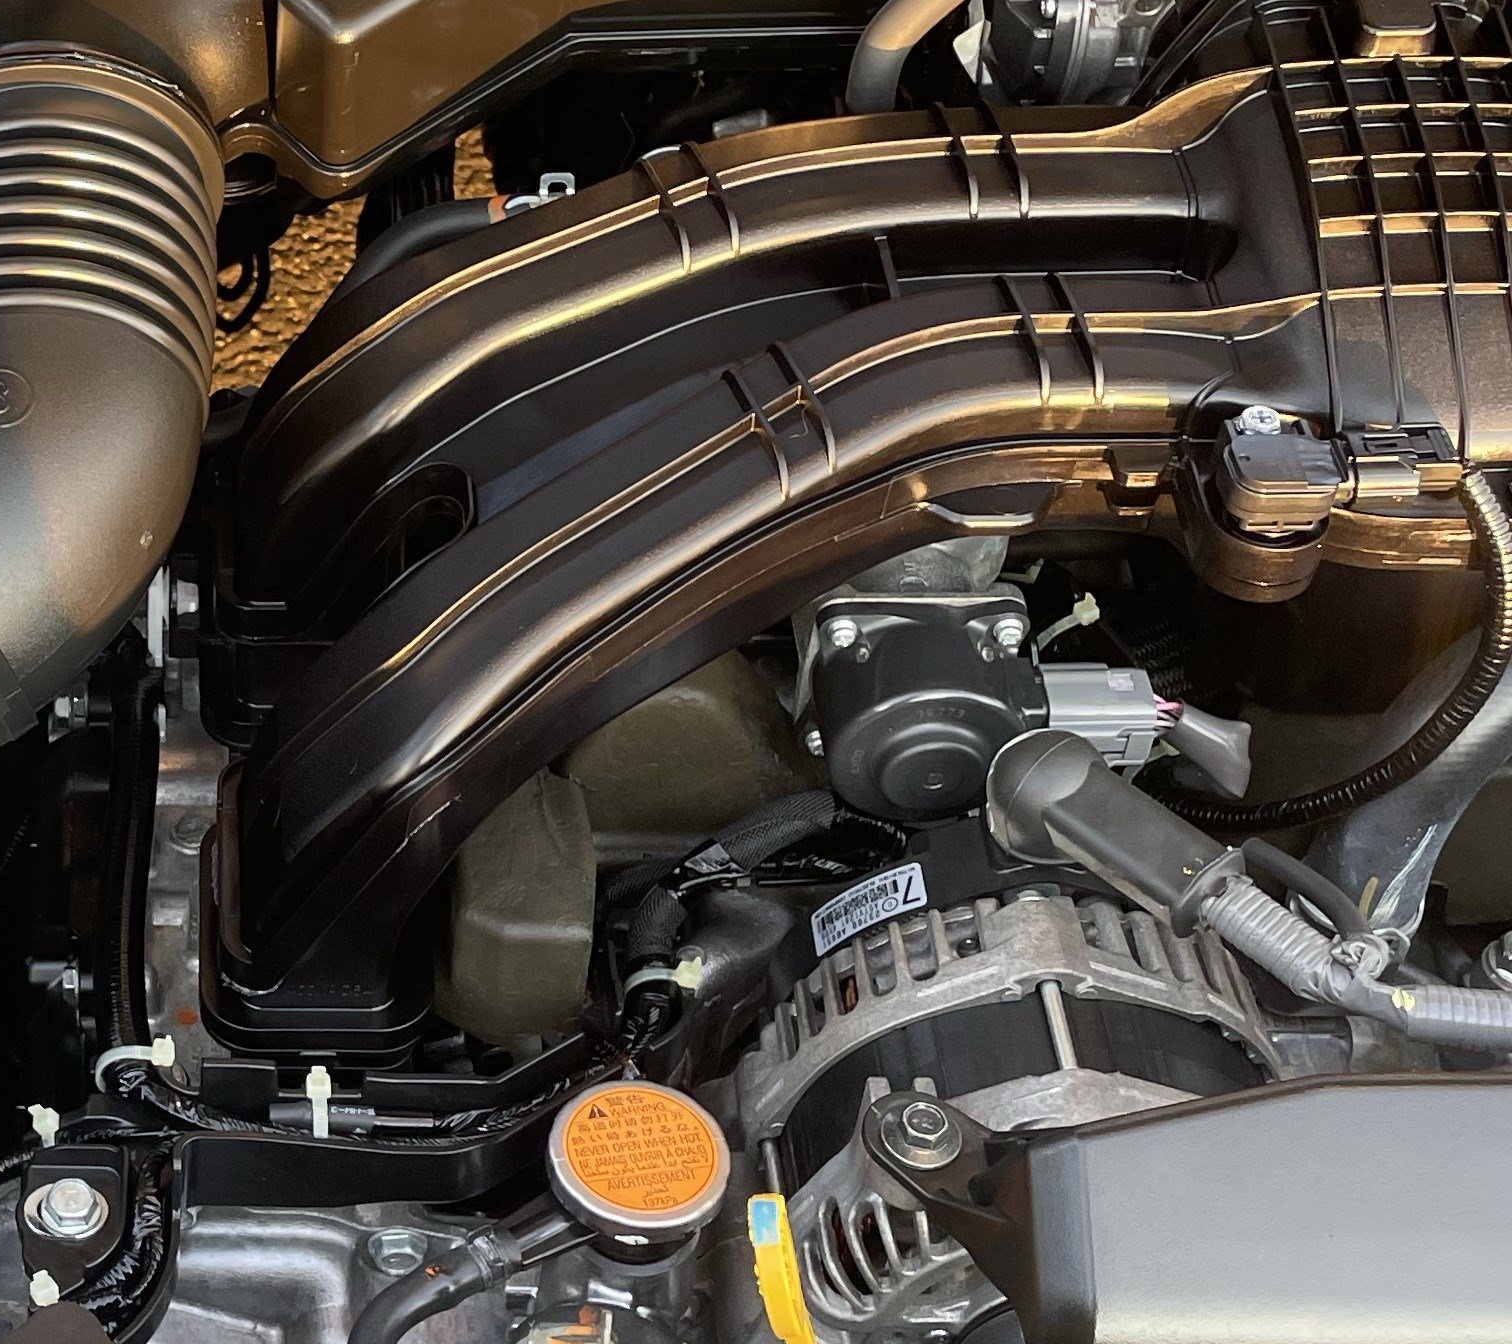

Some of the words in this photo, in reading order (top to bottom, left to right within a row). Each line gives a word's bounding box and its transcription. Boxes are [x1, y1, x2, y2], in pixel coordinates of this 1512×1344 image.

[902, 875, 921, 905] 7
[608, 1102, 666, 1117] WARNING
[574, 1144, 610, 1157] NEVER
[612, 1138, 641, 1154] OPEN
[643, 1135, 677, 1149] WHEN
[607, 1169, 696, 1192] AVERTISSEMENT
